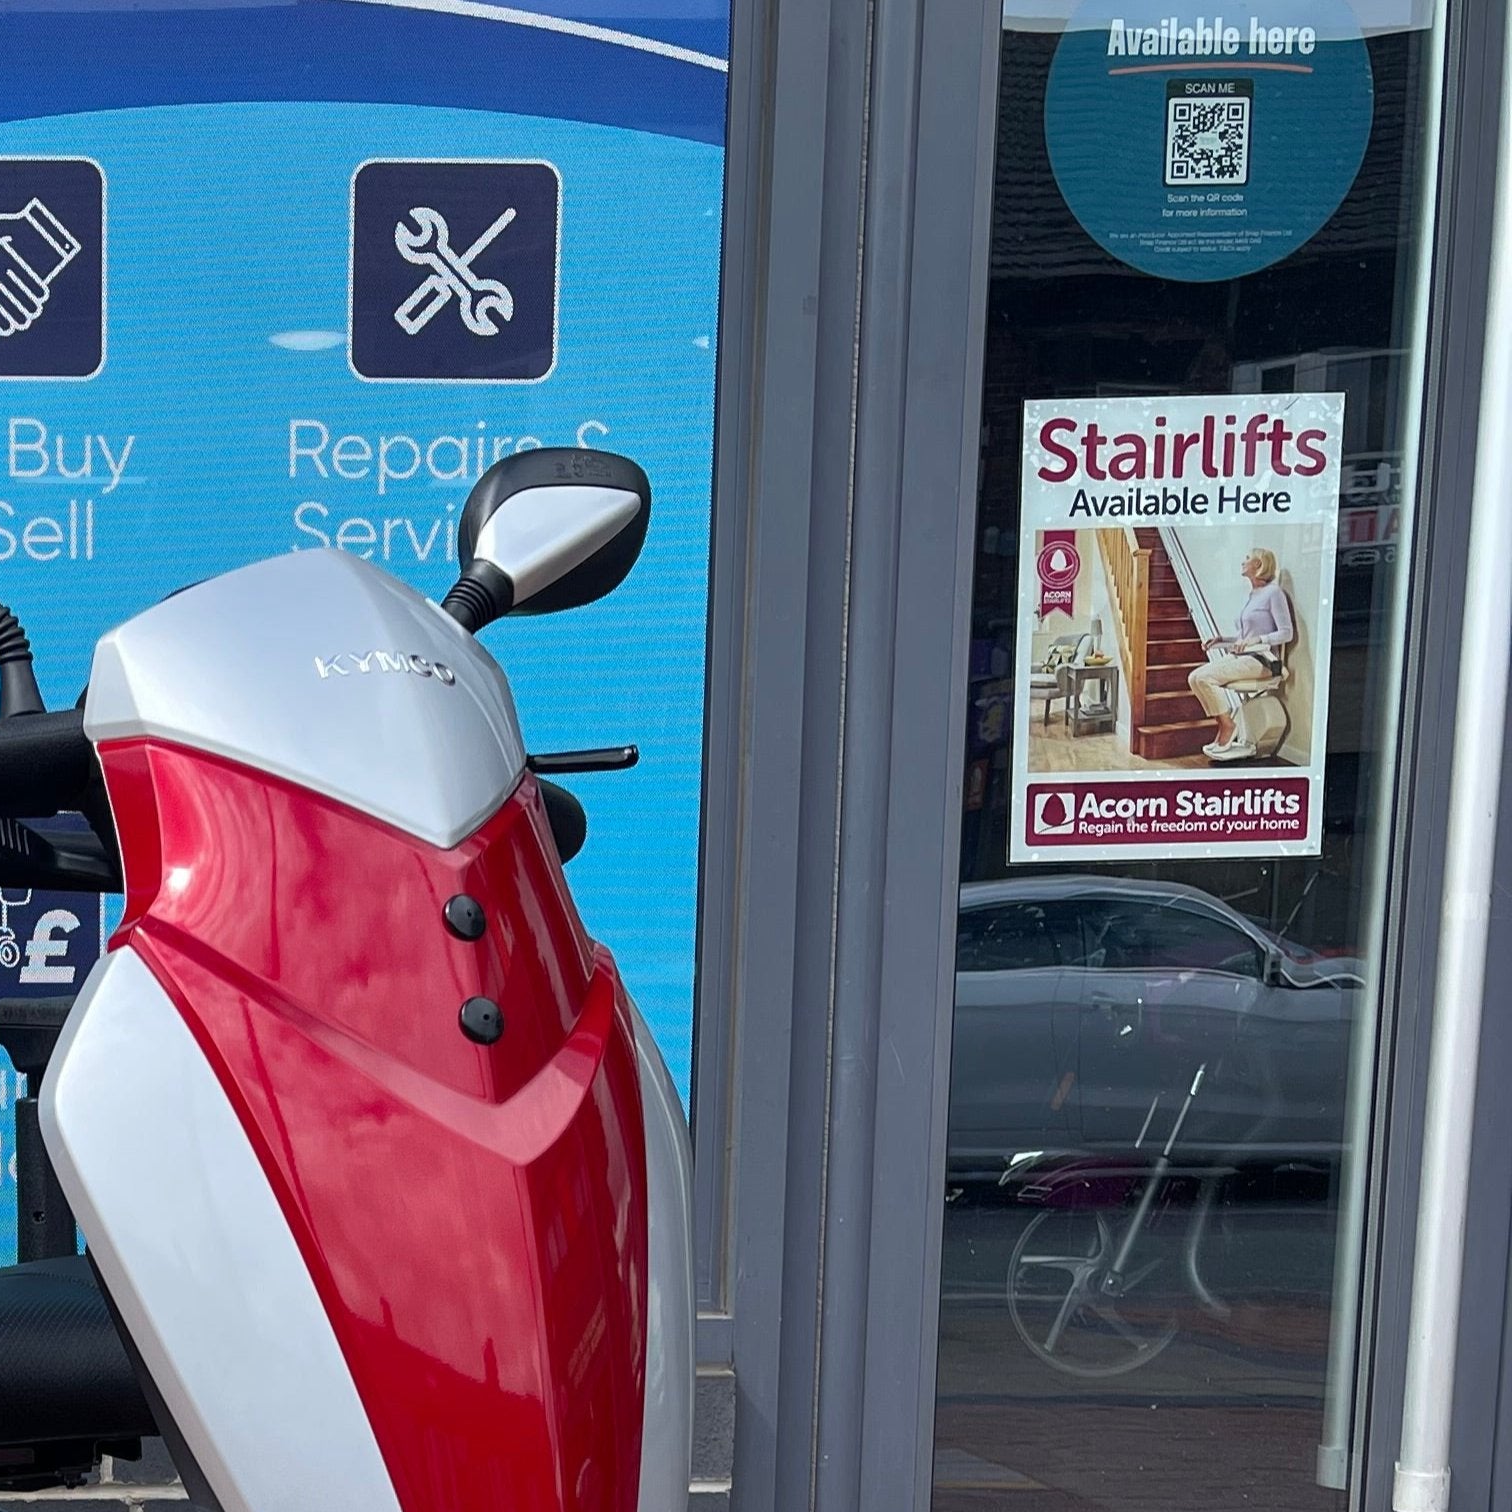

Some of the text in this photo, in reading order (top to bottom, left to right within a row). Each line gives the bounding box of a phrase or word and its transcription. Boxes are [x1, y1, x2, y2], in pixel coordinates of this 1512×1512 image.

[1107, 16, 1317, 56] Available here
[1184, 82, 1235, 95] SCAN ME
[1162, 208, 1247, 218] for more information
[1167, 193, 1244, 203] Scan the QR code
[8, 417, 136, 494] Buy
[1037, 413, 1328, 484] Stairlifts
[1069, 485, 1292, 518] Available Here
[292, 500, 455, 562] Servi
[1043, 590, 1072, 598] ACORN
[313, 649, 457, 687] KYMCO
[1078, 789, 1300, 819] Acorn Stairlifts
[1078, 816, 1300, 837] Regain the freedom of your home
